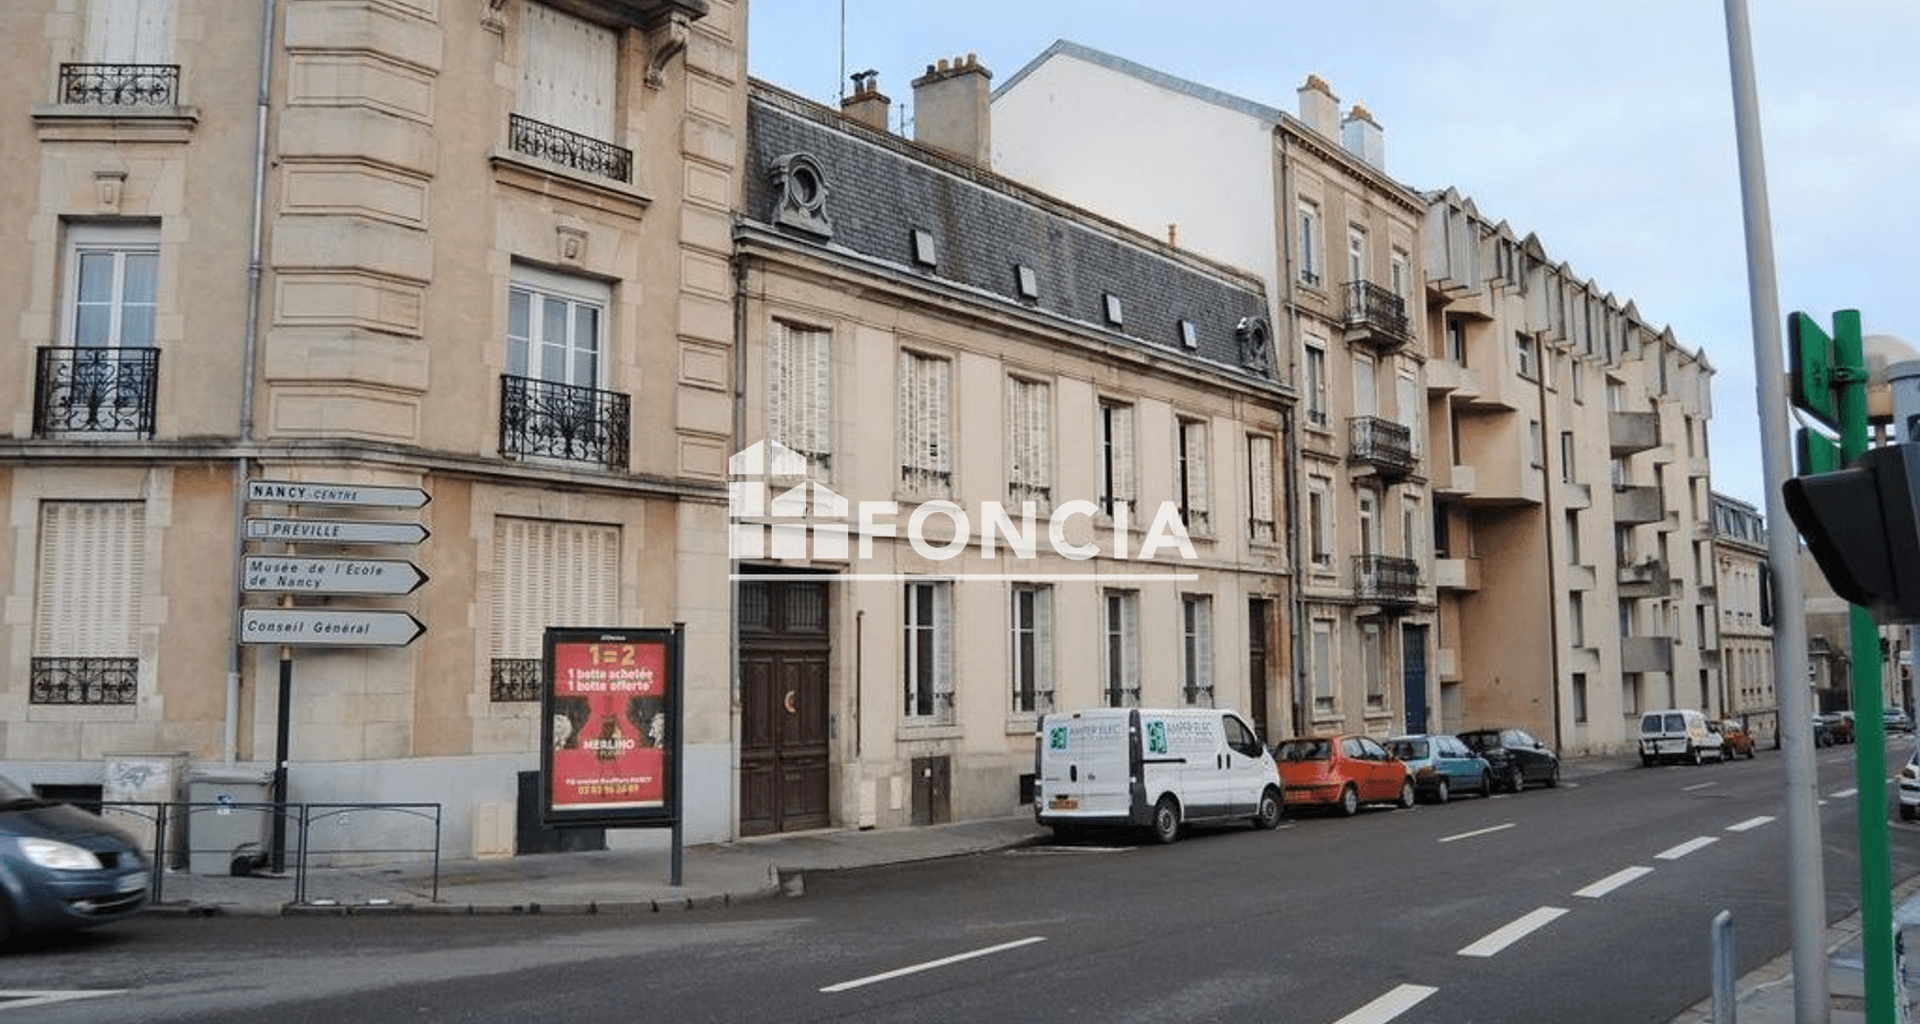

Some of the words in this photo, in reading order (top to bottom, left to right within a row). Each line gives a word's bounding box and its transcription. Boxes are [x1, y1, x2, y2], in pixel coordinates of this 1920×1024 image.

[250, 561, 298, 573] Musée
[308, 564, 325, 574] de
[250, 576, 267, 587] de
[277, 577, 321, 588] Nancy
[247, 620, 303, 633] Conseil
[313, 622, 370, 634] Général
